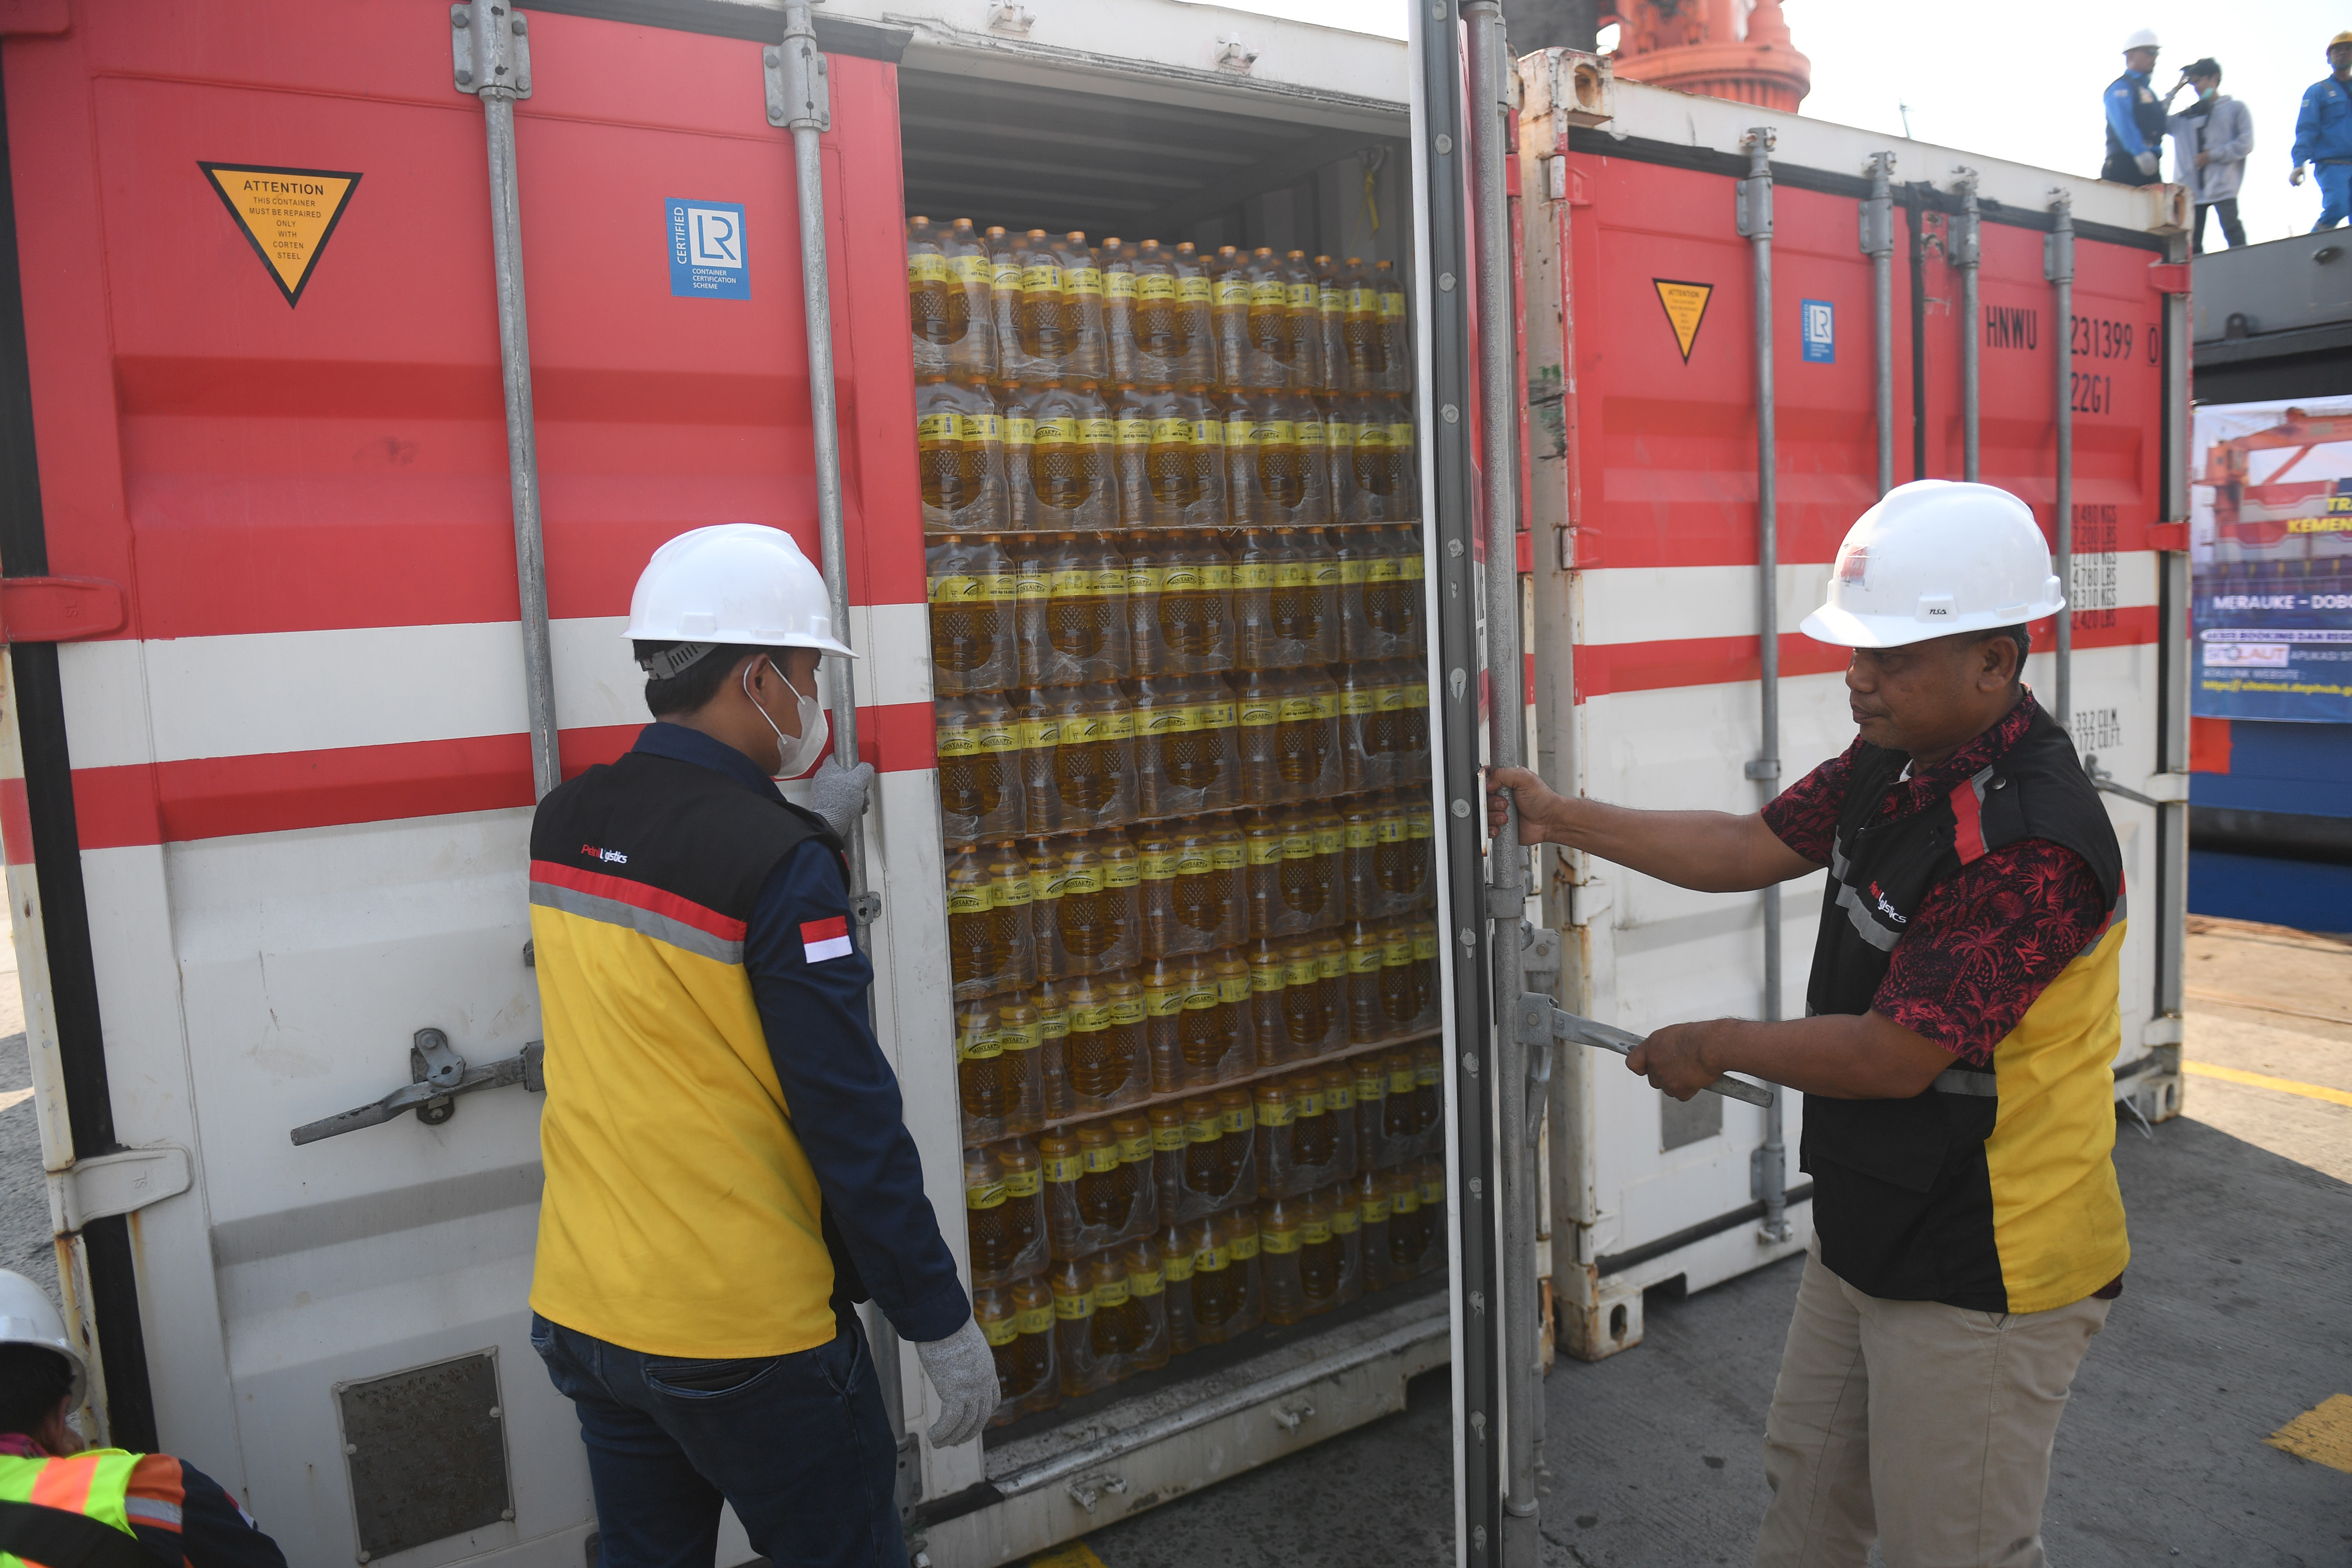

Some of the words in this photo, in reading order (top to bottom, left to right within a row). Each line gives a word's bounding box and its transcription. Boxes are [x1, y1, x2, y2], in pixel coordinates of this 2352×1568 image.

[244, 180, 323, 195] ATTENTION
[272, 198, 315, 207] CONTAINER
[284, 210, 321, 218] REPAIRED
[674, 207, 687, 264] CERTIFIED
[697, 215, 737, 260] LR
[693, 275, 736, 283] CERTIFICATION
[1986, 305, 2037, 350] HNWU
[2071, 315, 2133, 360] 231399
[2327, 497, 2352, 511] TR
[1170, 577, 1197, 586] MINYAKITA
[2102, 567, 2116, 586] LBS
[2102, 588, 2116, 607] KGS
[2213, 595, 2295, 610] MERAUKE
[2311, 594, 2352, 609] DOB
[1245, 714, 1273, 722] MINYAKITA
[941, 742, 973, 752] MINYAKITA
[982, 738, 1013, 748] MINYAKITA
[1180, 861, 1207, 870] MINYAKITA
[1065, 881, 1094, 890] MINYAKITA
[1187, 997, 1215, 1005] MINYAKITA
[972, 1044, 1001, 1055] MINYAKITA
